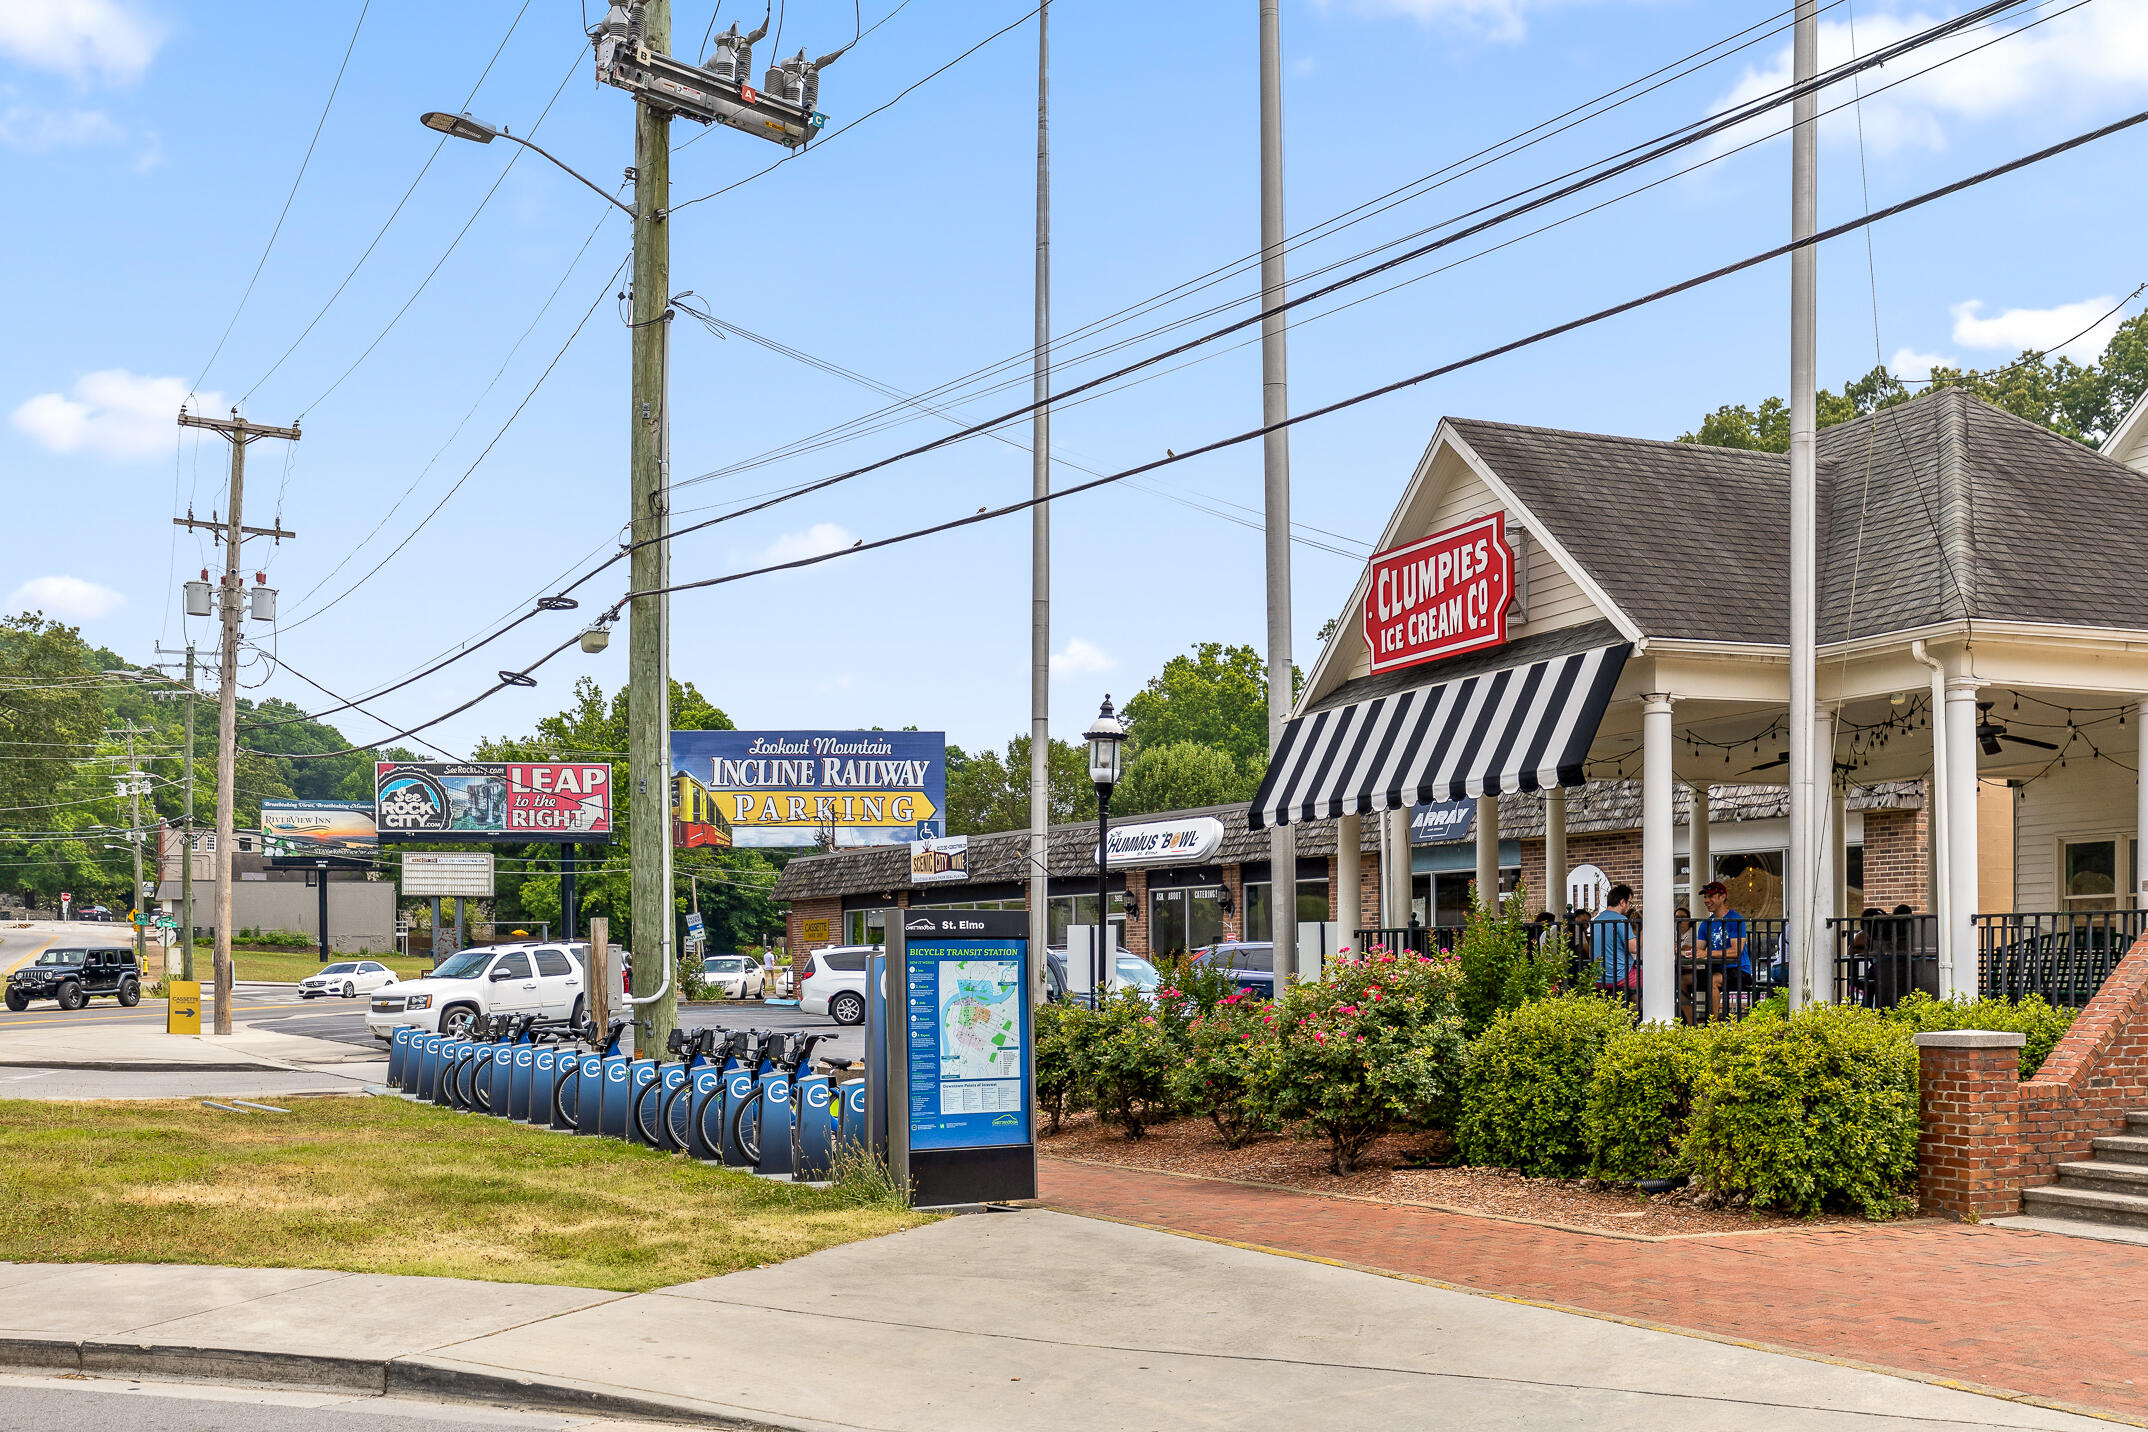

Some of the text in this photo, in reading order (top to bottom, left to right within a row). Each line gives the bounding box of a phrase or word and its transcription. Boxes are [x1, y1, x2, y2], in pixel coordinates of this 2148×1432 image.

[641, 52, 647, 60] B
[745, 89, 752, 99] A
[815, 114, 822, 124] C
[1377, 538, 1488, 623] CLUMPIES
[1380, 623, 1404, 654] ICE
[1407, 594, 1463, 646] CREAM
[749, 737, 892, 756] Lookout Mountain
[511, 767, 607, 794] LEAP
[710, 756, 930, 788] INCLINE RAILWAY
[394, 787, 422, 802] See
[513, 793, 556, 807] to the
[381, 801, 435, 815] ROCK
[733, 794, 914, 822] PARKING
[511, 809, 586, 828] RIGHT
[1411, 807, 1470, 828] ARRAY
[1107, 834, 1158, 853] HUMMUS
[913, 852, 965, 873] SCENIC CITY WINE
[1156, 889, 1218, 900] ASK ABOUT CATERING!
[804, 922, 827, 933] CASSETTE
[942, 921, 957, 930] St.
[959, 920, 985, 930] Elmo
[909, 948, 1018, 956] BICYCLE TRANSIT STATION
